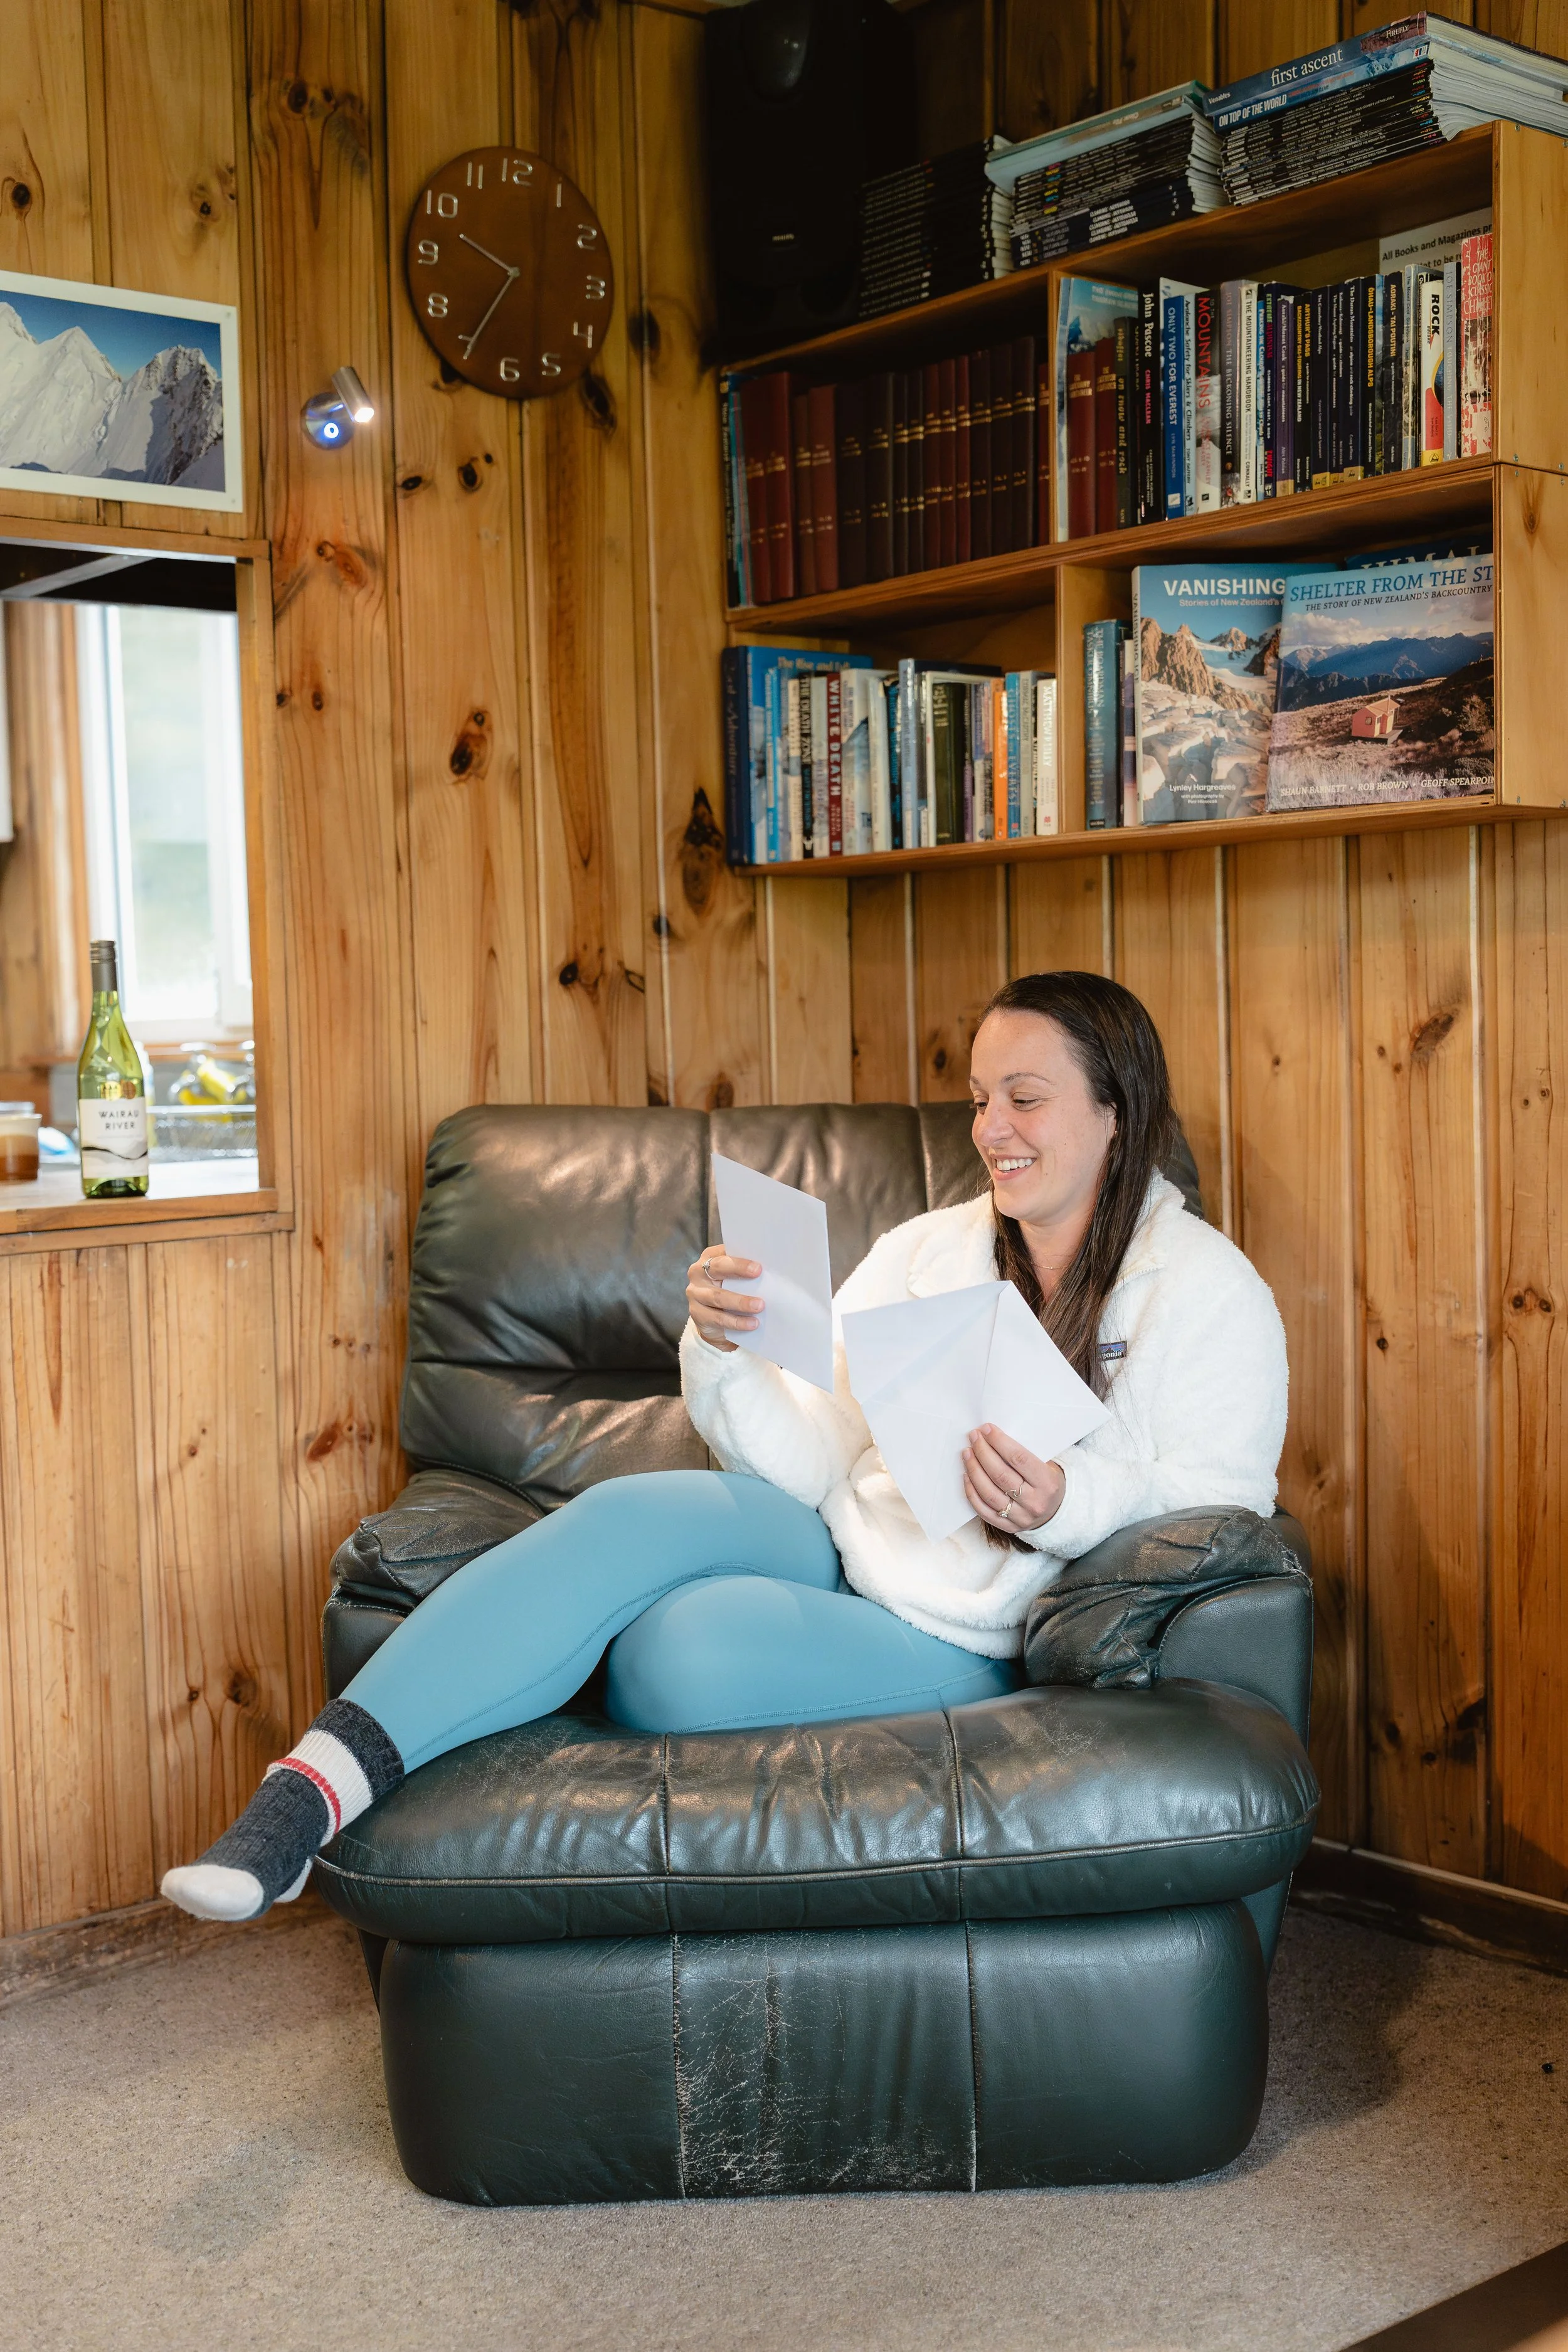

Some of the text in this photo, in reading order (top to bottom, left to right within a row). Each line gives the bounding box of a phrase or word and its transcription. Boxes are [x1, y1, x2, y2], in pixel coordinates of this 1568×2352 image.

[1270, 65, 1298, 87] first
[1301, 48, 1343, 77] ascent
[1385, 24, 1409, 40] FIREFLY
[1219, 94, 1287, 127] ON TOP OF THE WORLD
[467, 161, 484, 189] 11
[502, 158, 533, 186] 12
[426, 190, 458, 218] 10
[557, 183, 562, 208] 1
[578, 225, 597, 250] 2
[1382, 224, 1493, 261] All Books and Magazines pr
[418, 240, 438, 265] 9
[1434, 258, 1441, 268] to
[1444, 253, 1453, 263] be
[1477, 249, 1488, 258] THE
[586, 275, 605, 300] 3
[1468, 273, 1486, 286] BOOK
[428, 293, 448, 318] 8
[1142, 292, 1155, 318] John
[1431, 294, 1440, 336] ROCK
[573, 322, 593, 349] 4
[1144, 322, 1154, 358] Pascoe
[541, 352, 561, 377] 5
[1197, 297, 1211, 408] MOUNTAINS
[500, 358, 520, 383] 6
[1168, 307, 1177, 425] ONLY TWO FOR EVEREST
[1118, 378, 1128, 474] on snow and rock
[1163, 578, 1285, 596] VANISHING
[1290, 565, 1493, 601] SHELTER FROM THE ST
[1179, 598, 1209, 607] Stories
[1210, 598, 1219, 607] of
[1221, 598, 1238, 607] New
[1240, 598, 1279, 606] Zealand's
[1305, 603, 1322, 611] THE
[1323, 600, 1348, 610] STORY
[1363, 597, 1383, 606] NEW
[1384, 591, 1429, 603] ZEALAND'S
[1431, 585, 1493, 598] BACKCOUNTRY
[778, 656, 793, 668] The
[801, 678, 810, 696] THE
[801, 699, 810, 734] DEATH
[829, 679, 841, 736] WHITE
[1043, 686, 1052, 734] MATTHEW
[801, 738, 810, 763] ZONE
[1008, 689, 1017, 805] GHOSTS EVEREST
[829, 742, 841, 796] DEATH
[1169, 783, 1236, 792] Lynley Hargreaves
[1280, 785, 1346, 797] SHAUN BARNETT
[1358, 781, 1409, 792] ROB BROWN
[1421, 776, 1495, 788] GEOFF SPEARPOIN
[98, 1110, 139, 1118] WAIRAU
[105, 1121, 136, 1130] RIVER
[1101, 1350, 1123, 1359] gonia
